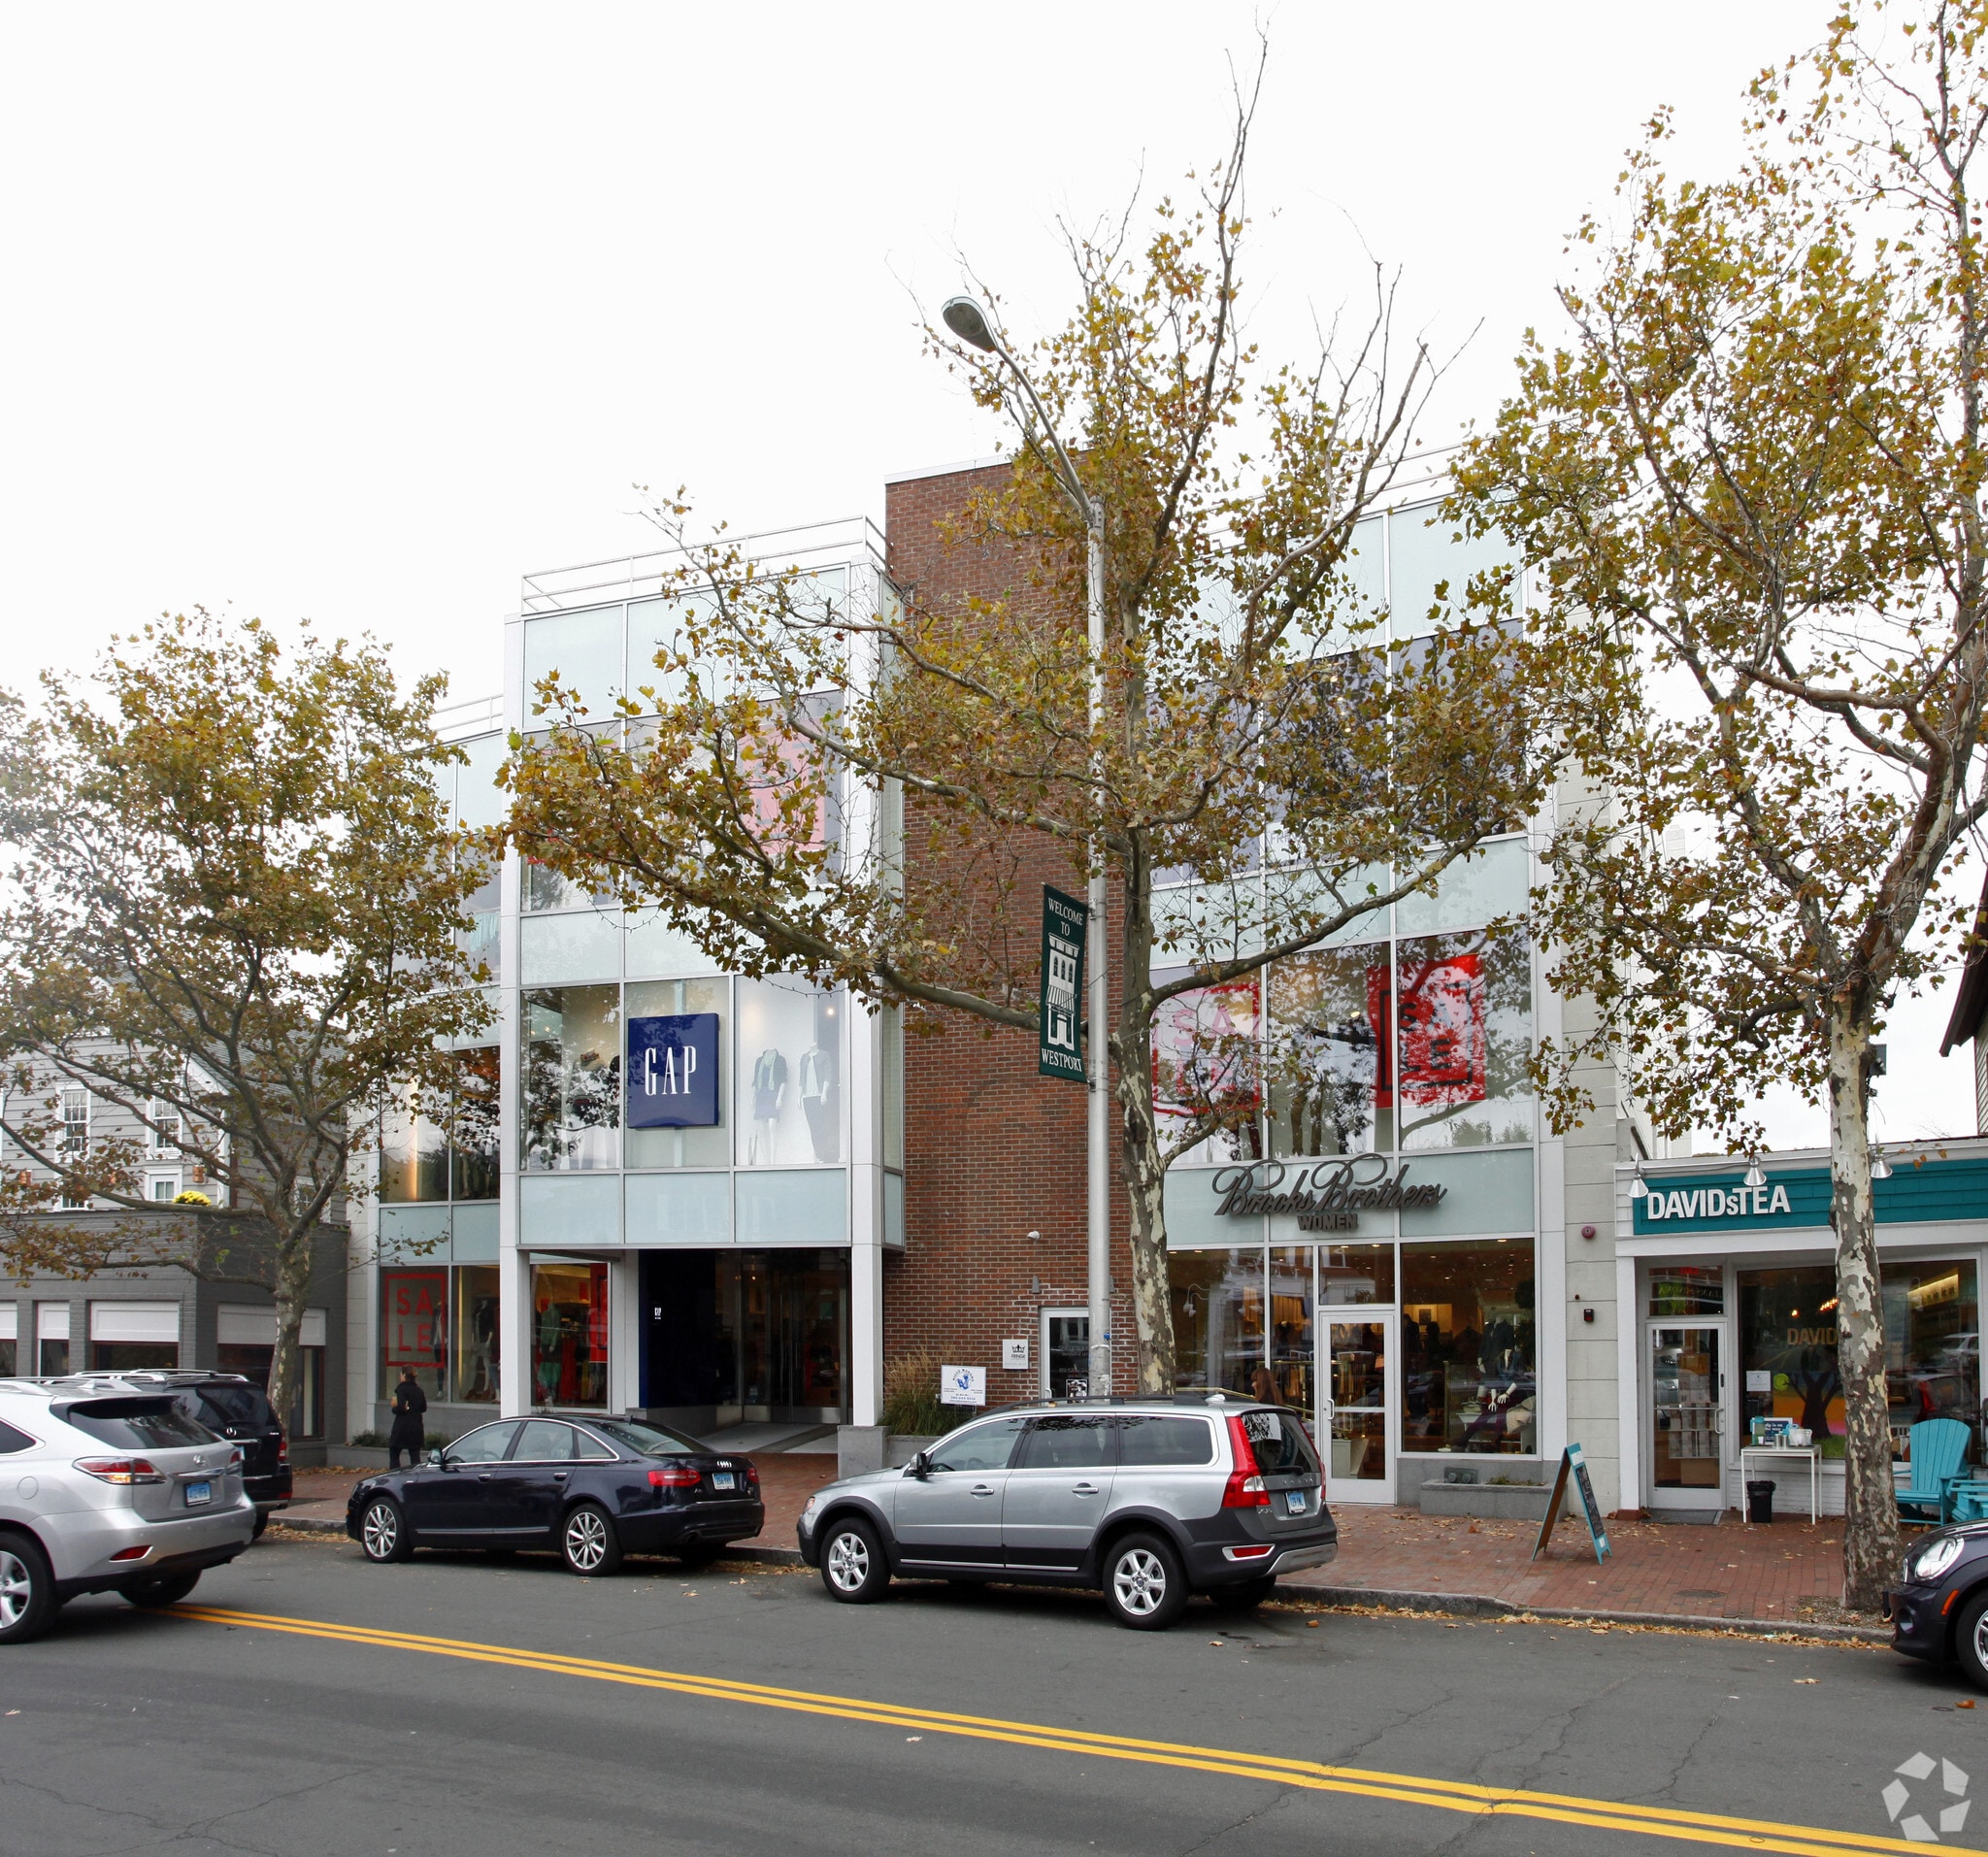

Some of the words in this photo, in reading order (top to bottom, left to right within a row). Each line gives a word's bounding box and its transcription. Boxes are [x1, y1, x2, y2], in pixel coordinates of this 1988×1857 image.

[1047, 897, 1084, 926] WELCOME
[1061, 921, 1071, 936] TO
[645, 1045, 697, 1096] GAP
[1042, 1047, 1082, 1073] WESTPORT
[1212, 1158, 1316, 1216] Brooks
[1310, 1152, 1448, 1212] Brothers
[1647, 1184, 1792, 1220] DAVIDsTEA
[1296, 1213, 1359, 1232] WOMEN
